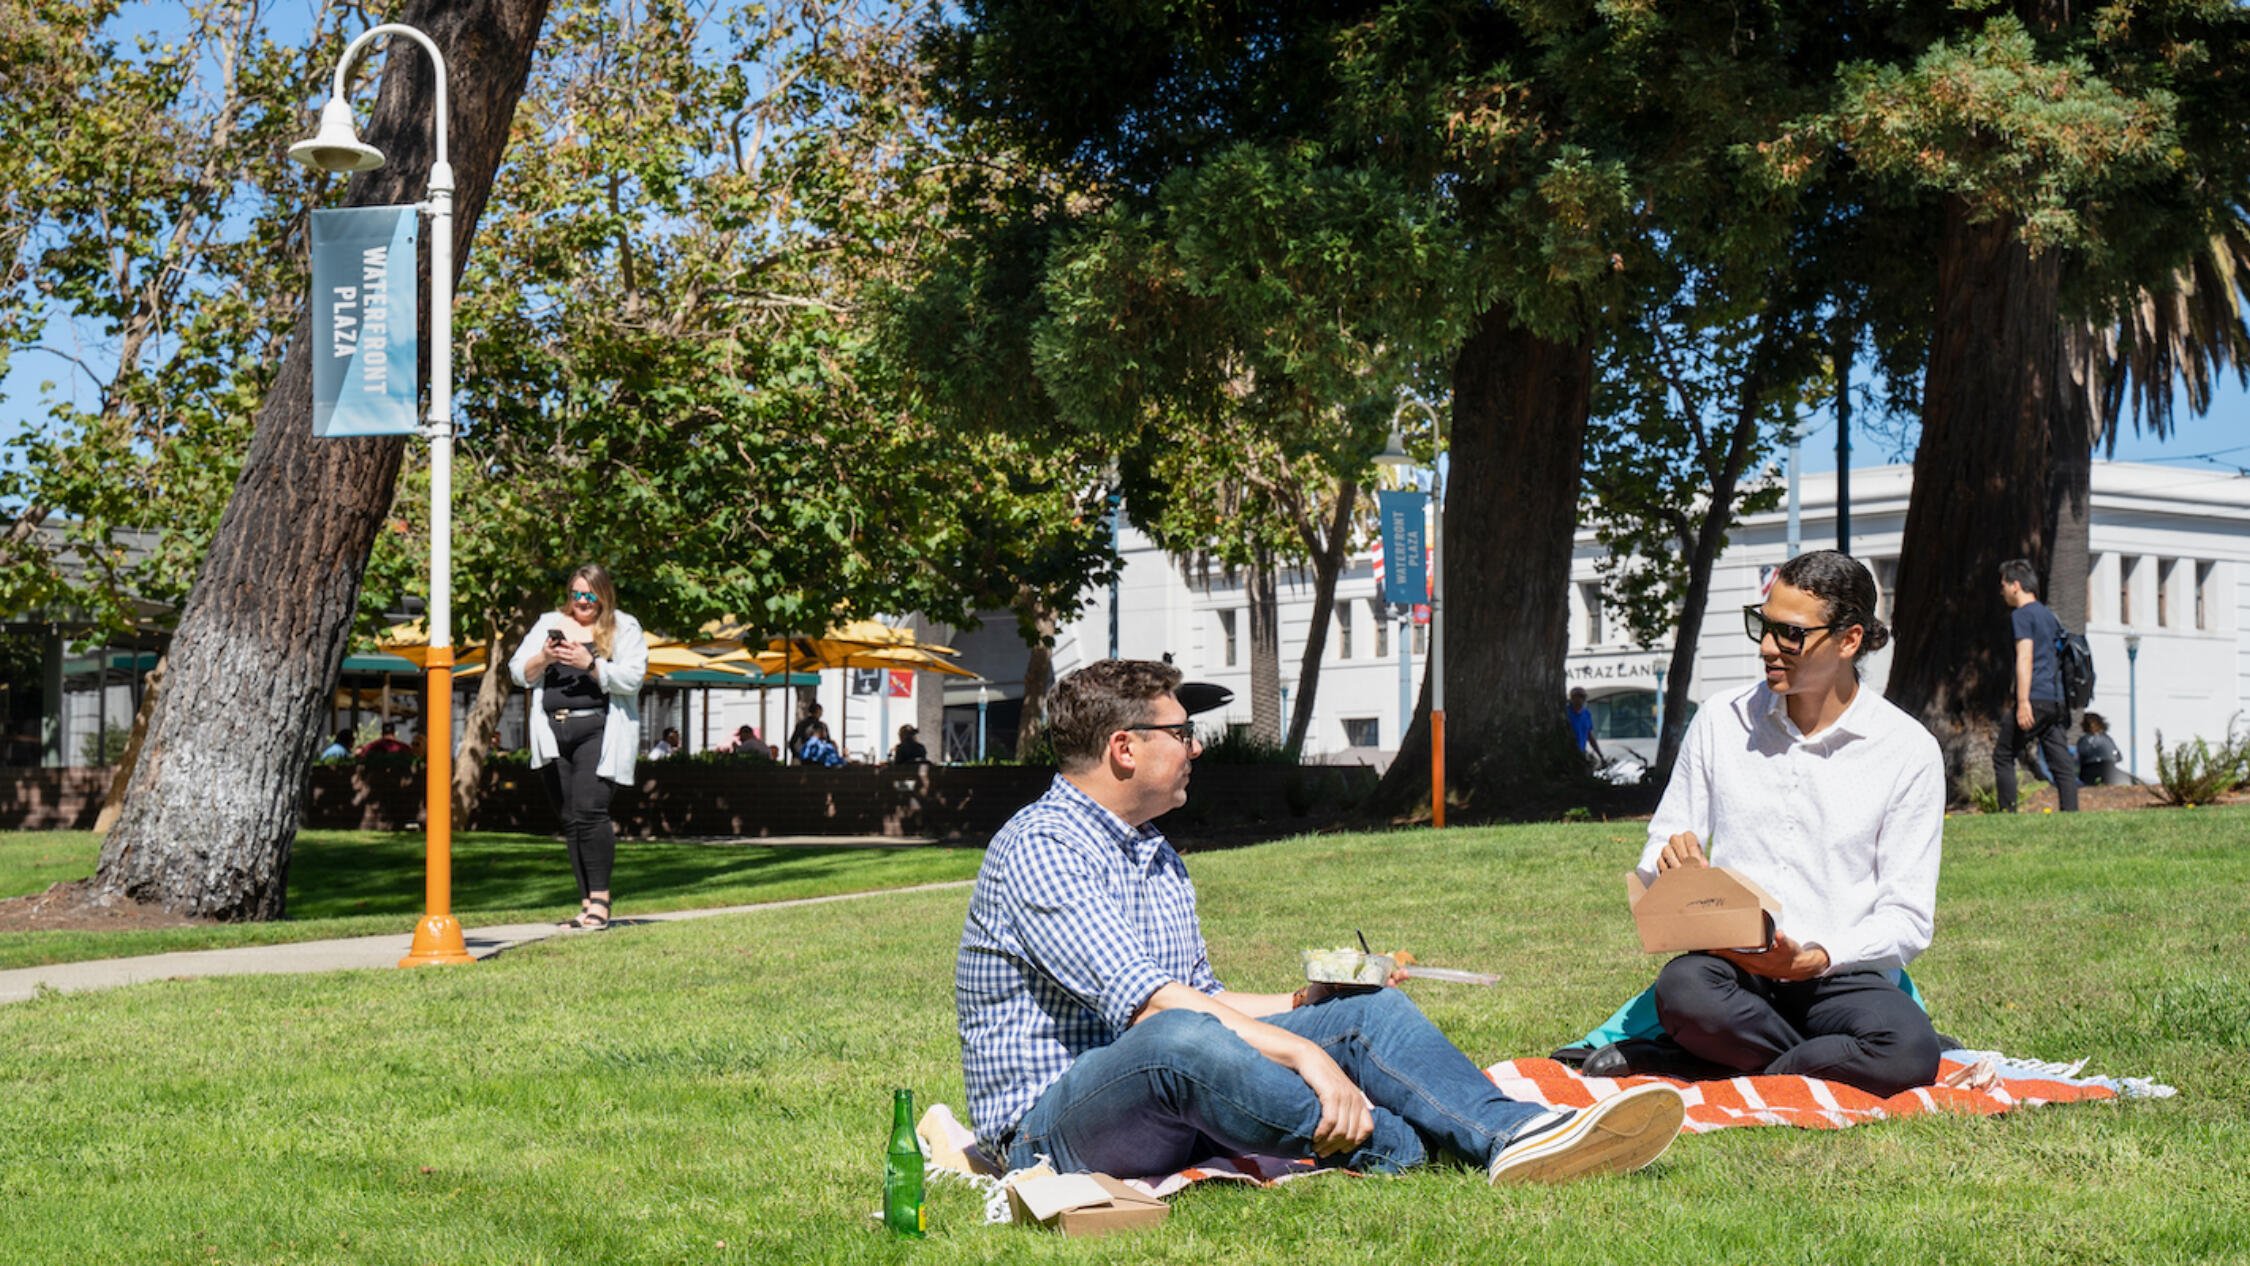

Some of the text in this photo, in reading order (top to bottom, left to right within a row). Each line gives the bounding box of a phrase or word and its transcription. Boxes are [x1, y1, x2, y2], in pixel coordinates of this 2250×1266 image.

[333, 286, 357, 358] PLAZA
[363, 246, 387, 394] WATERFRONT
[1392, 511, 1406, 584] WATERFRONT
[1408, 531, 1418, 567] PLAZA
